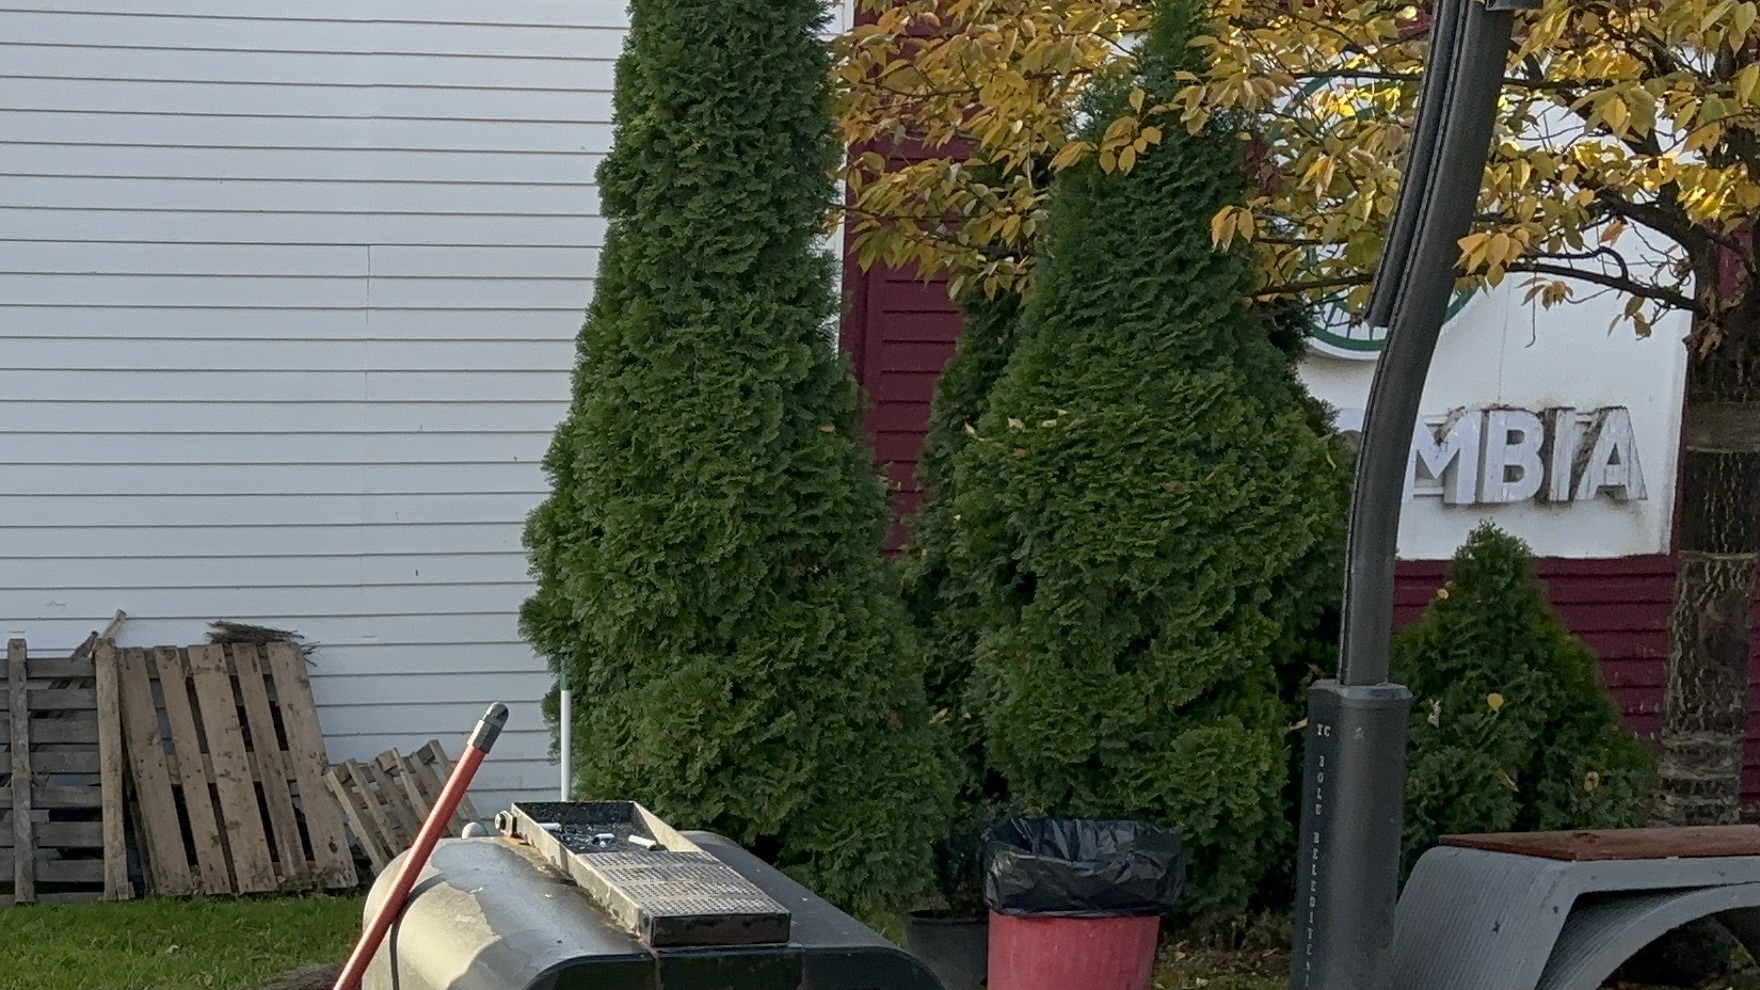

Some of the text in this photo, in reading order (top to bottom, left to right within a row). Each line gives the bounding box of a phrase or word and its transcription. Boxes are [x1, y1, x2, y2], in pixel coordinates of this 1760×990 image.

[1338, 406, 1648, 504] MBIA
[1316, 723, 1331, 737] TC
[1315, 755, 1325, 816] BOLU
